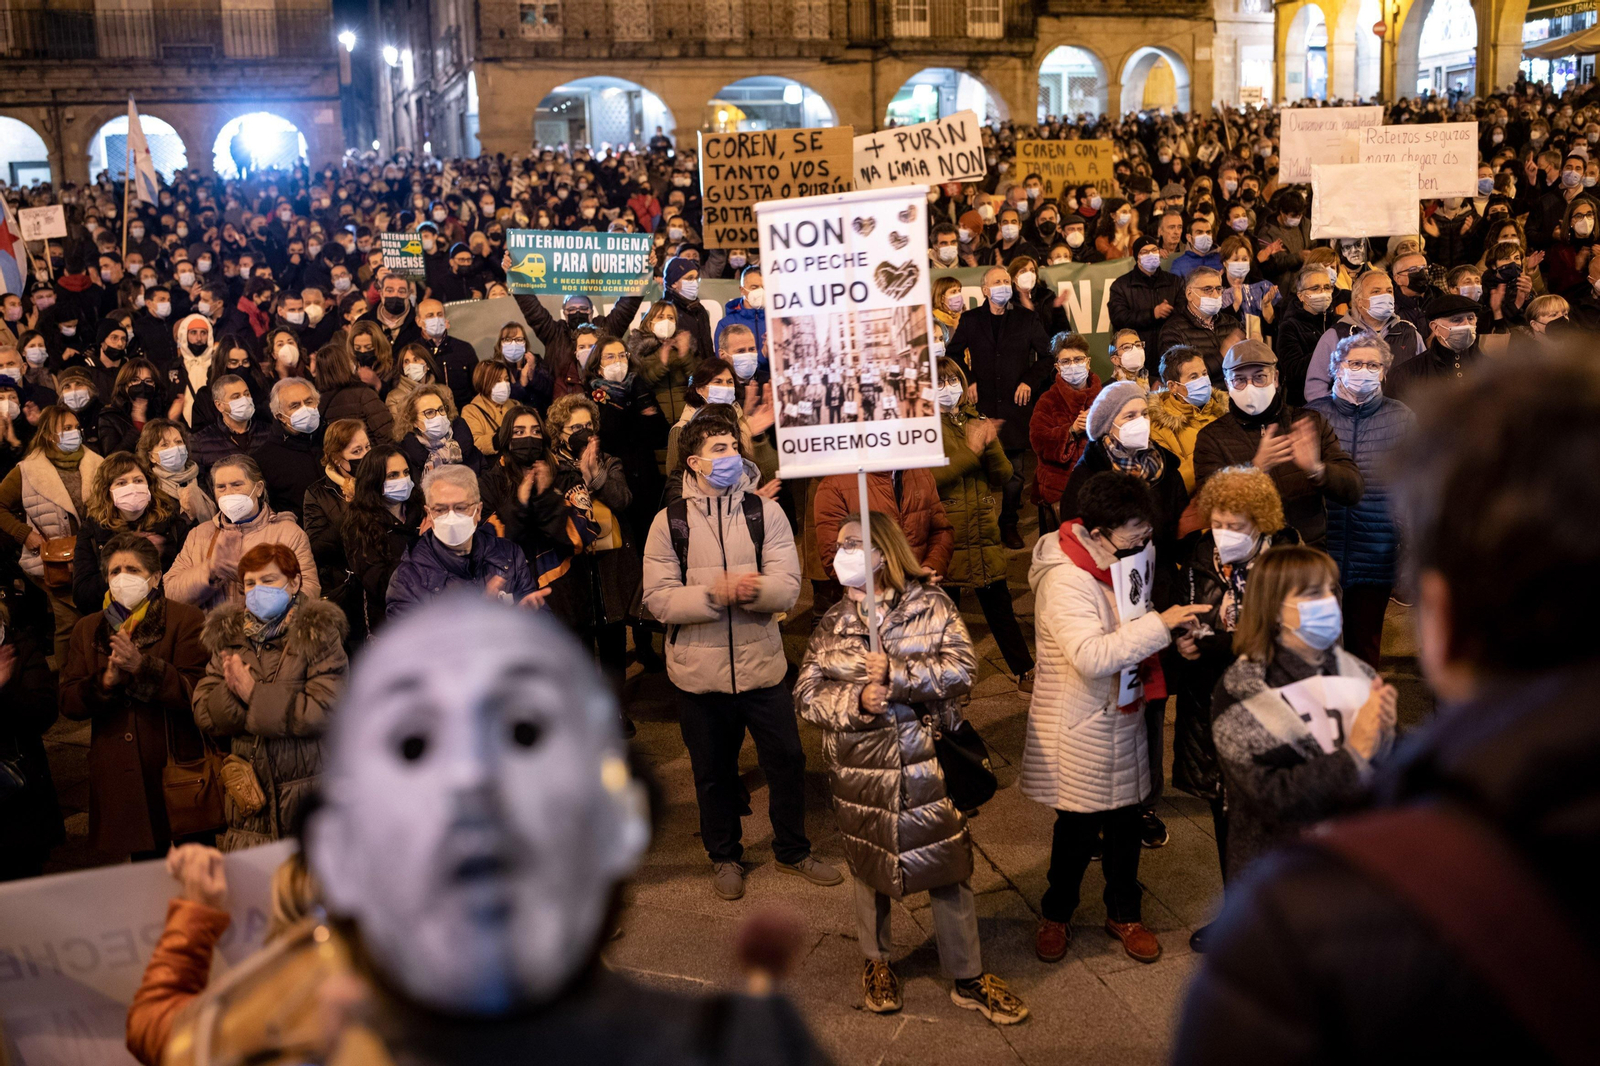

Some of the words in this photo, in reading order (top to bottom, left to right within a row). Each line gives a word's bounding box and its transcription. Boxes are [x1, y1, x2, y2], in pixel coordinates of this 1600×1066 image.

[706, 132, 785, 160] COREN,
[793, 131, 823, 153] SE
[894, 117, 967, 153] PURÍN
[1366, 127, 1420, 144] Roteiros
[1424, 130, 1470, 148] seguros
[1022, 142, 1066, 159] COREN
[709, 164, 779, 182] TANTO
[790, 160, 829, 181] VOS
[861, 165, 882, 185] NA
[938, 146, 984, 177] NON
[1088, 162, 1098, 175] A
[707, 184, 773, 203] GUSTA
[781, 183, 791, 199] O
[380, 232, 422, 241] INTERMODAL
[381, 240, 402, 248] DIGNA
[510, 233, 602, 250] INTERMODAL
[606, 237, 650, 251] DIGNA
[769, 217, 844, 251] NON
[382, 248, 400, 256] PARA
[383, 256, 425, 269] OURENSE
[553, 252, 588, 273] PARA
[592, 253, 649, 274] OURENSE
[769, 258, 797, 275] AO
[803, 251, 869, 272] PECHE
[560, 278, 602, 286] NECESARIO
[624, 279, 649, 287] TODOS
[773, 292, 803, 310] DA
[810, 280, 869, 307] UPO
[782, 432, 891, 455] QUEREMOS
[897, 428, 938, 446] UPO
